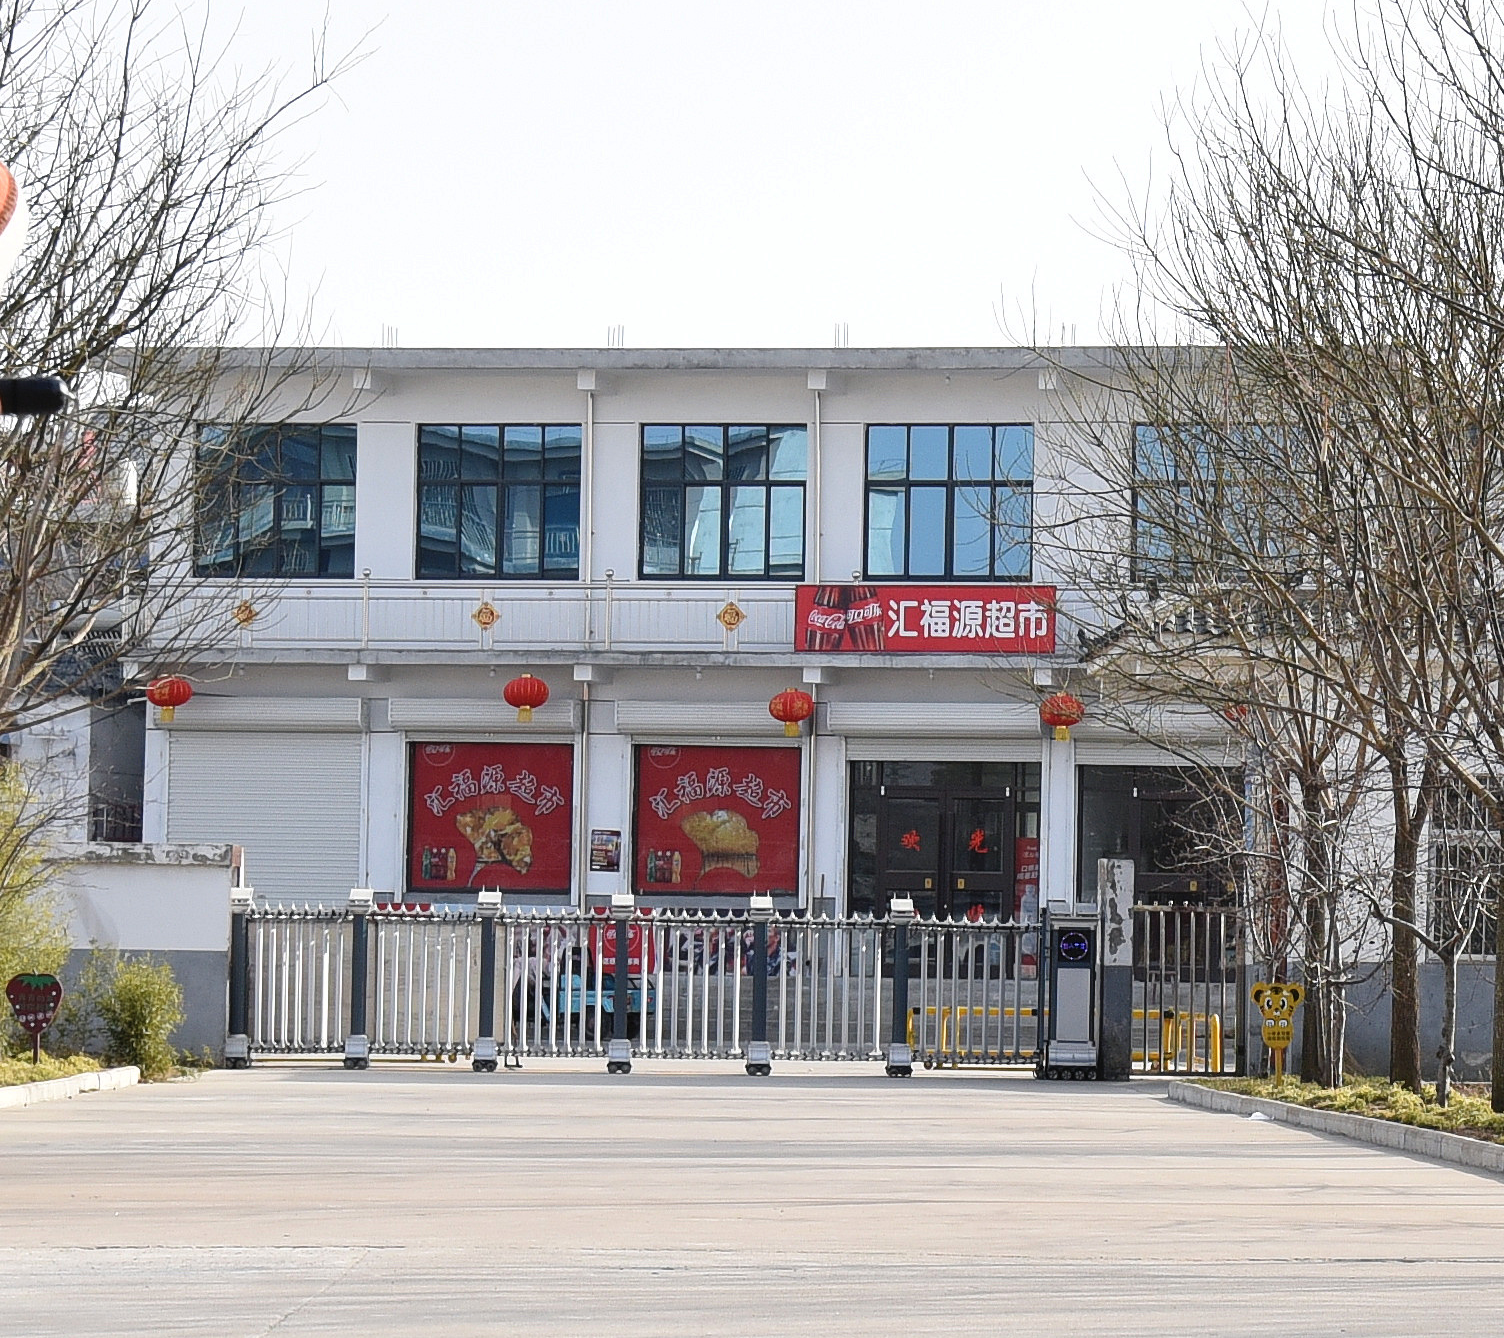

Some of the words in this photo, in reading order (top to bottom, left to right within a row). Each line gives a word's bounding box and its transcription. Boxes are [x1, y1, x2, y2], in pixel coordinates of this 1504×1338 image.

[887, 598, 1047, 639] 汇福源超市
[424, 764, 564, 817] 汇福源超市
[649, 767, 792, 820] 汇福源超市
